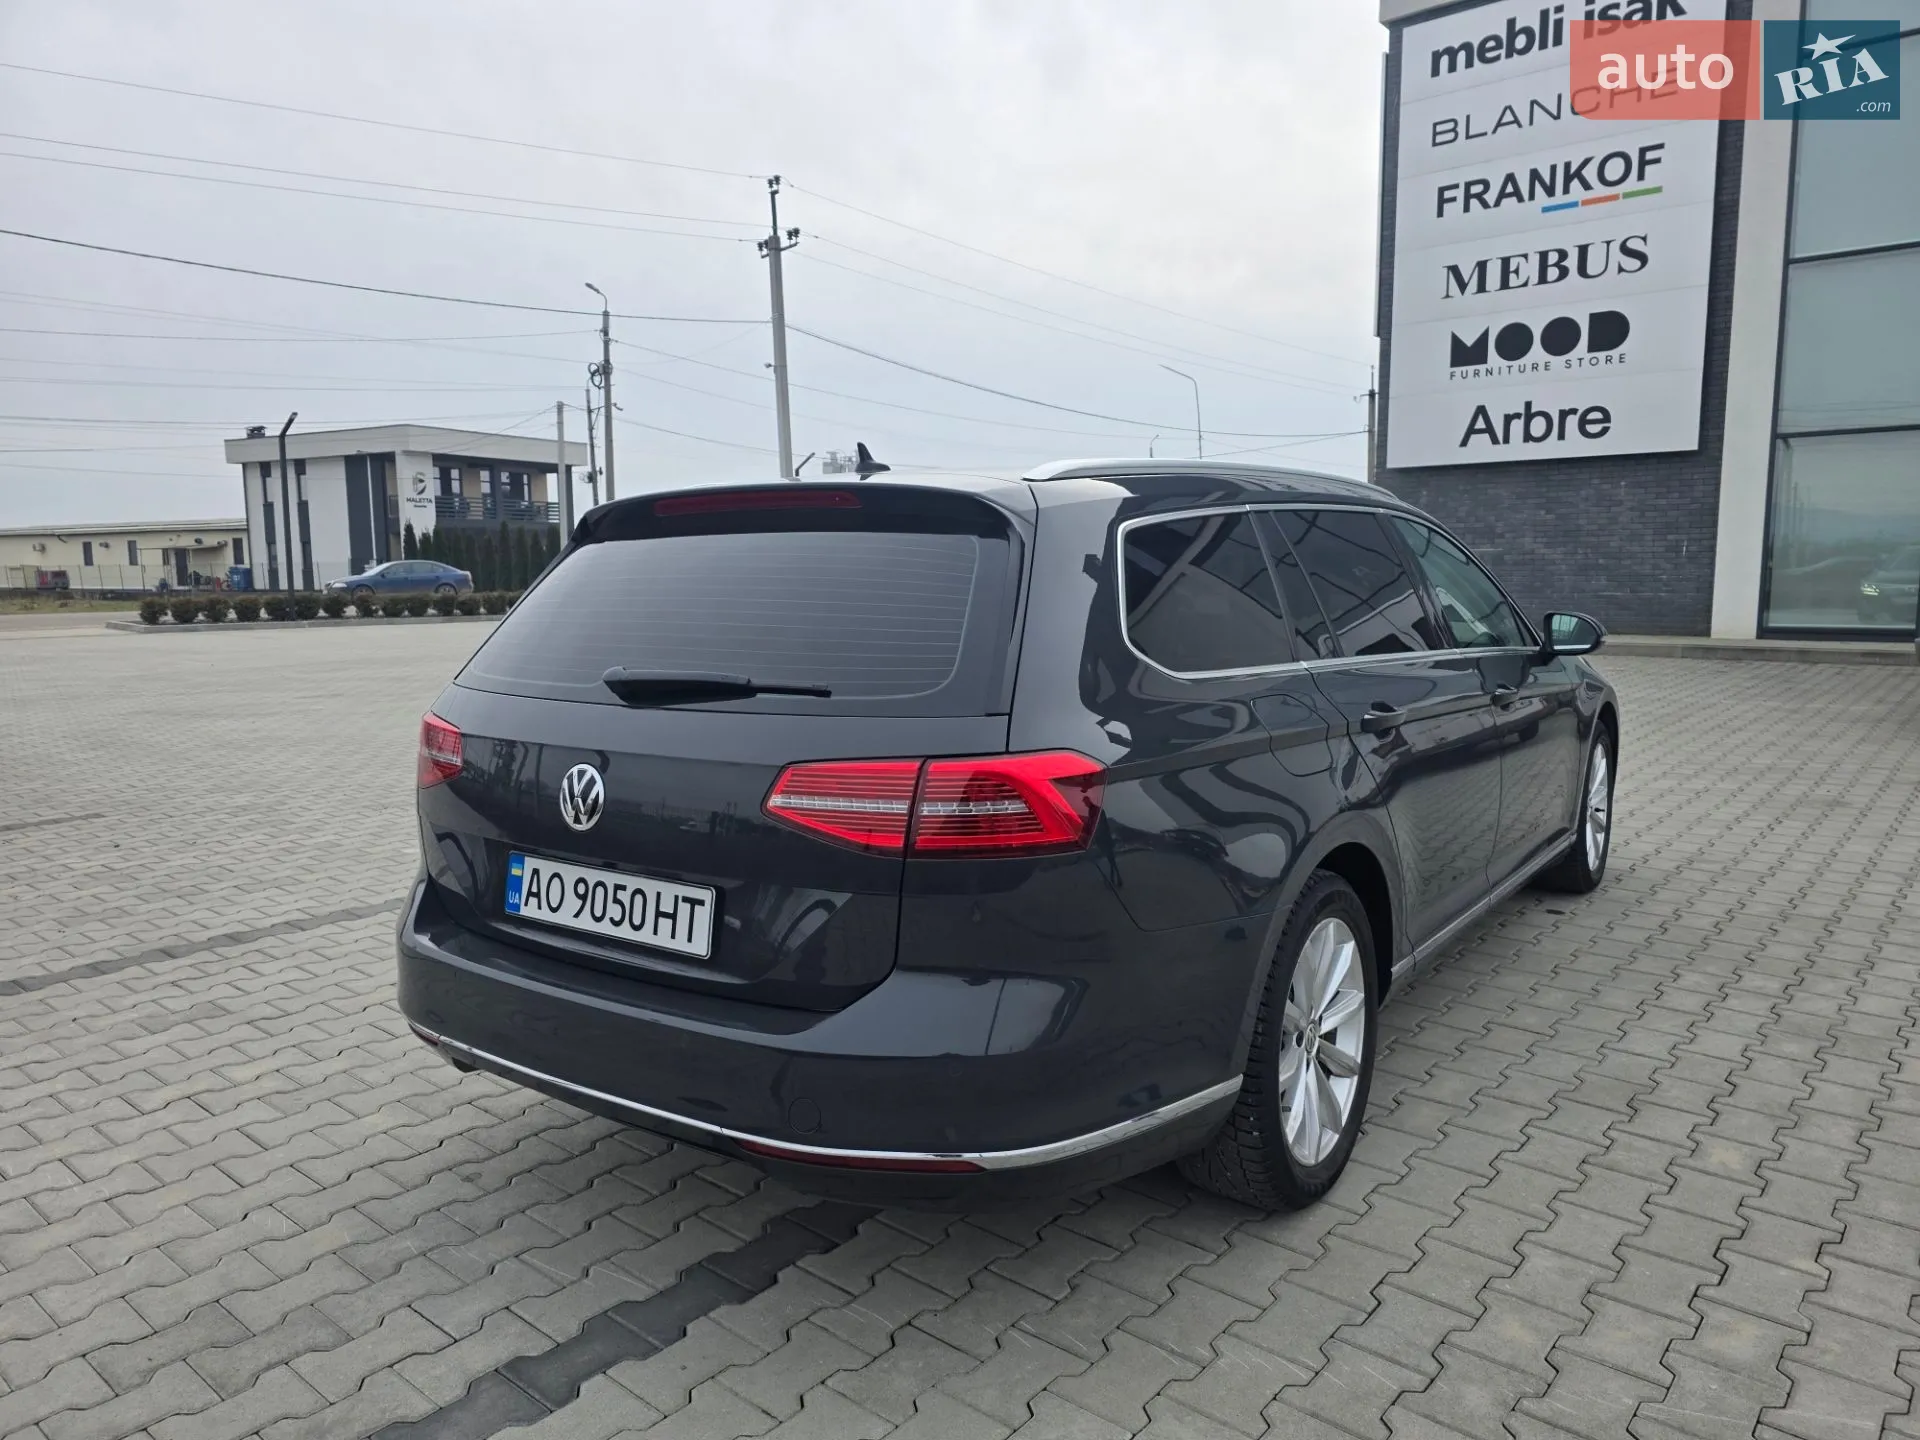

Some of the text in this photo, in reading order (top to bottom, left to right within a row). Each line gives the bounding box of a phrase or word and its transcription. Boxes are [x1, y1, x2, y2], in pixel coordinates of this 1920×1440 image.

[1430, 4, 1565, 78] mebli
[1431, 67, 1679, 148] BLANCHE
[1436, 143, 1666, 218] FRANKOF
[1440, 233, 1649, 299] MEBUS
[1450, 310, 1630, 368] MOOD
[1450, 353, 1627, 381] FURNITURE STORE
[1458, 400, 1612, 448] Arbre
[508, 890, 520, 904] UA
[523, 867, 706, 944] AO 9050 HT
